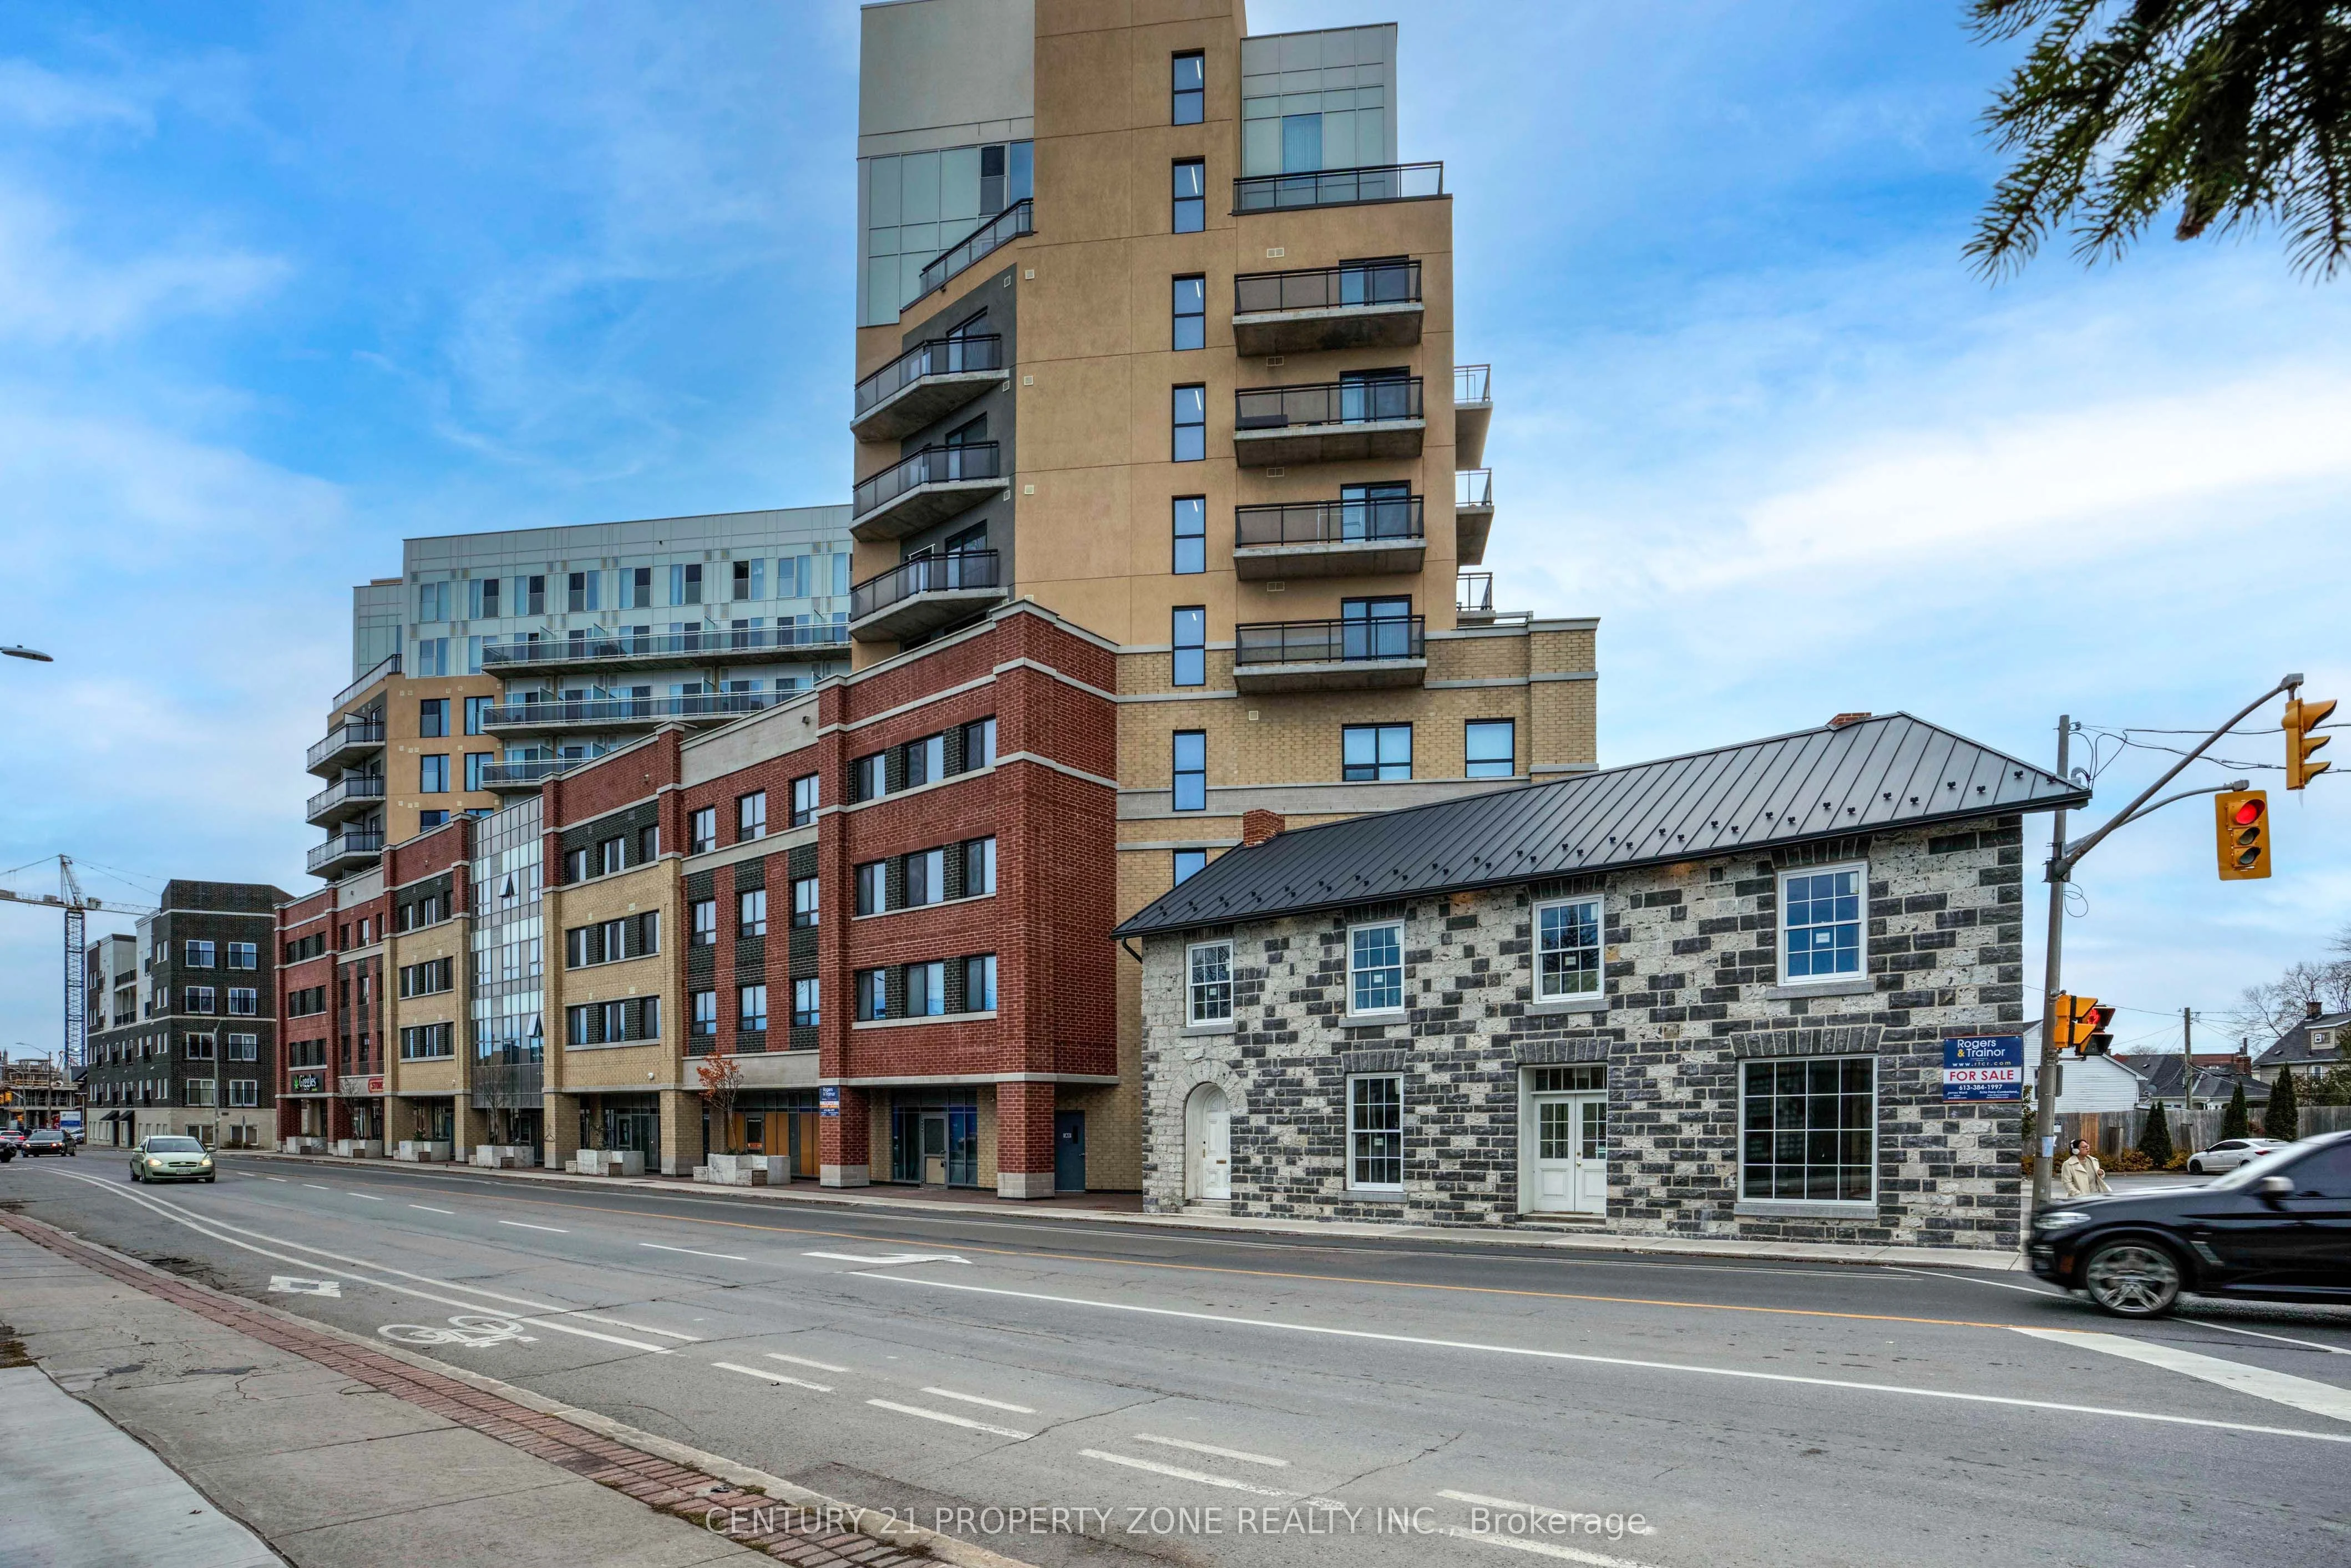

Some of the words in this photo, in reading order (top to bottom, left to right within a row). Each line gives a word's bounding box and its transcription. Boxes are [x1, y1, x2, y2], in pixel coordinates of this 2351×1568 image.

[1957, 1039, 1997, 1049] Rogers
[1966, 1048, 2005, 1057] Trainor
[1949, 1071, 1976, 1081] FOR
[1981, 1070, 2014, 1080] SALE
[299, 1074, 316, 1090] Giggles
